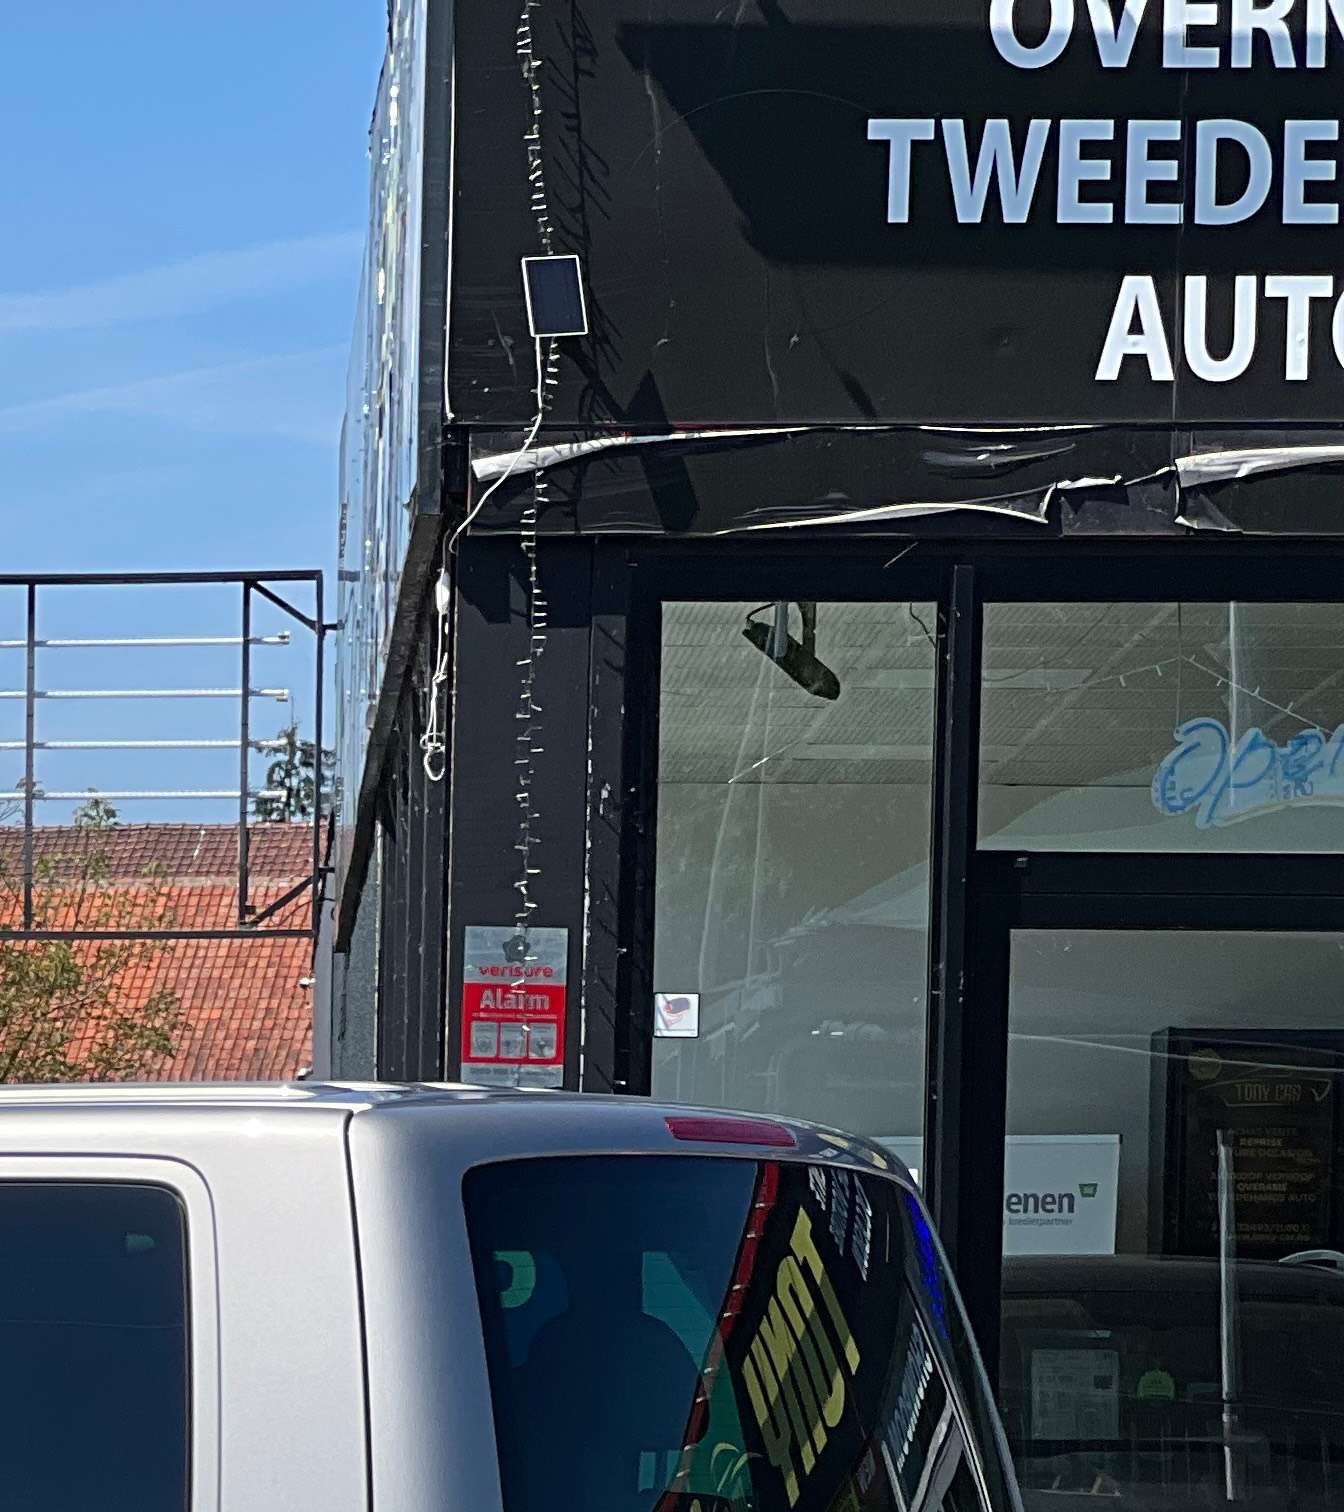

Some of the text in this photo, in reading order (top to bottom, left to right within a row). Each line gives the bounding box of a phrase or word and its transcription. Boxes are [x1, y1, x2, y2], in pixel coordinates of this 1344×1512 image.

[867, 118, 1341, 225] TWEEDE
[1095, 275, 1344, 382] AUT
[478, 964, 554, 978] verisure
[479, 988, 550, 1010] Alarm
